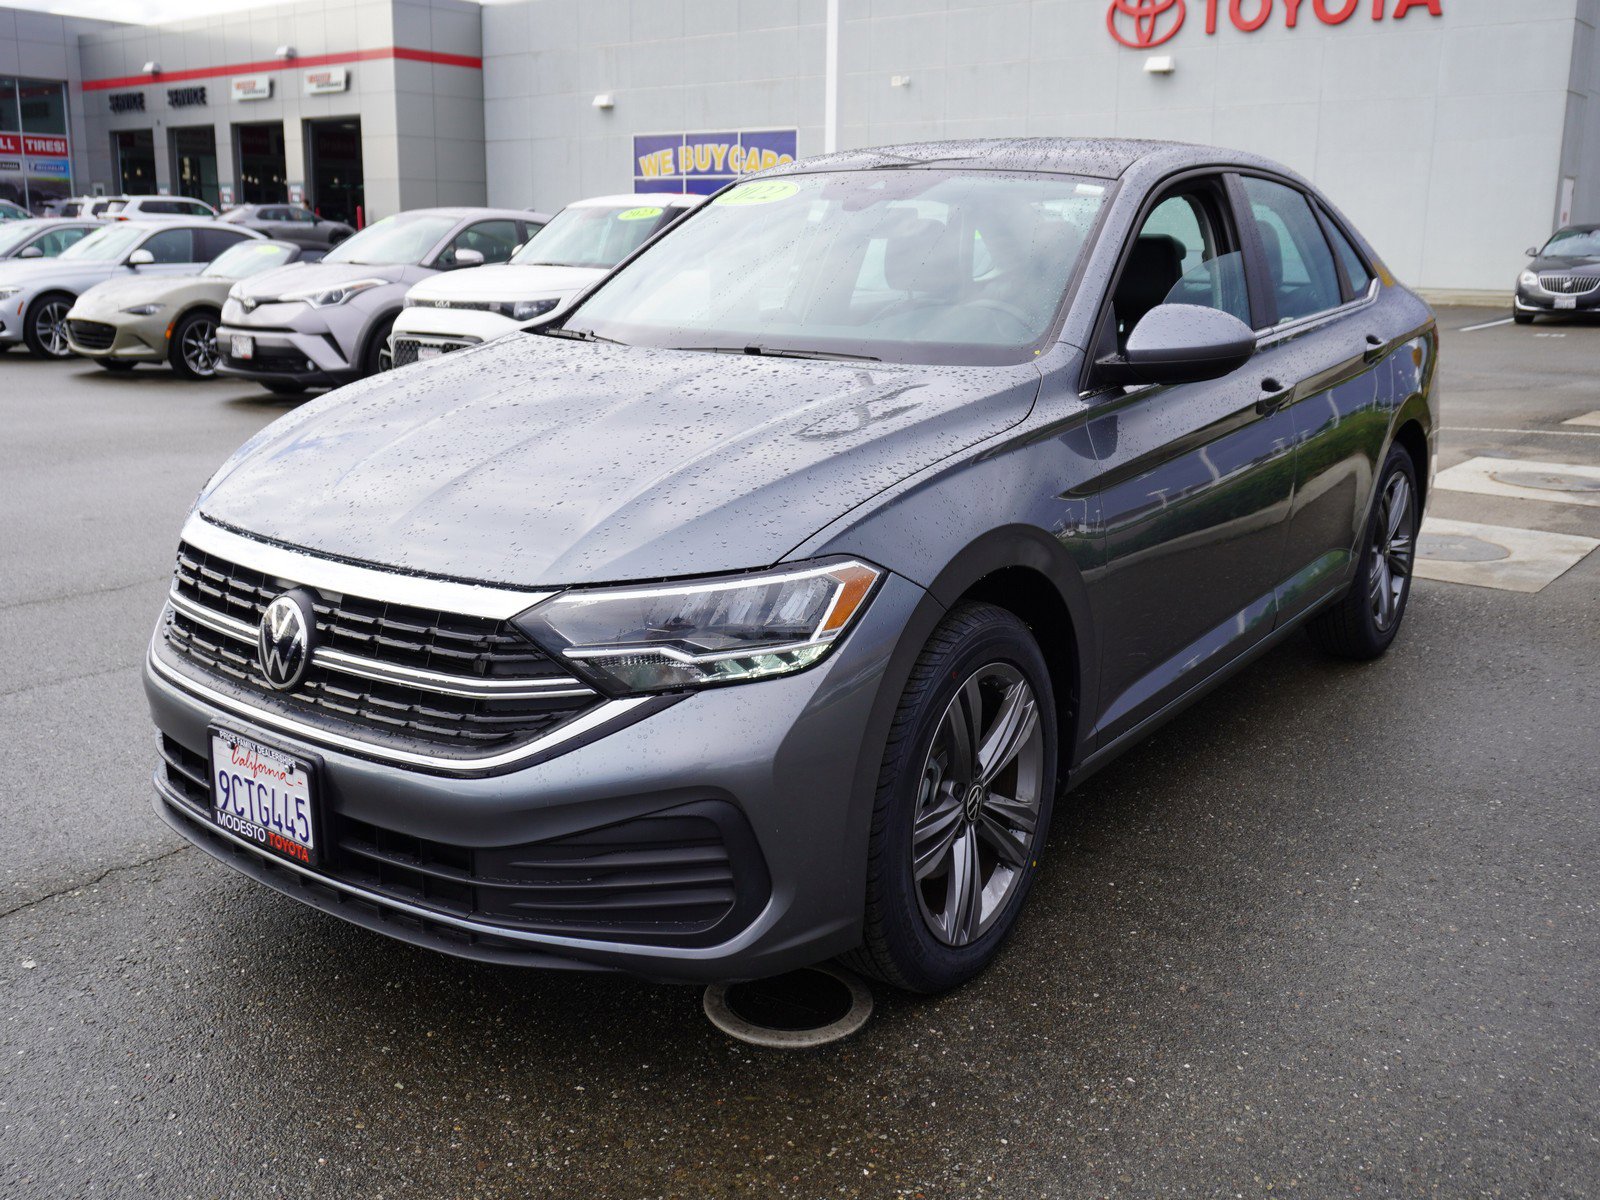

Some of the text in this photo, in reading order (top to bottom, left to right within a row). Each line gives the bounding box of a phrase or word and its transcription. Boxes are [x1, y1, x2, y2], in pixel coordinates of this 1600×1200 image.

[26, 139, 65, 153] TIRES!
[639, 149, 675, 177] WE
[679, 144, 729, 172] BUY
[232, 744, 293, 787] California
[219, 770, 310, 843] 9CTG445
[217, 811, 309, 862] MODESTO TOYOTA
